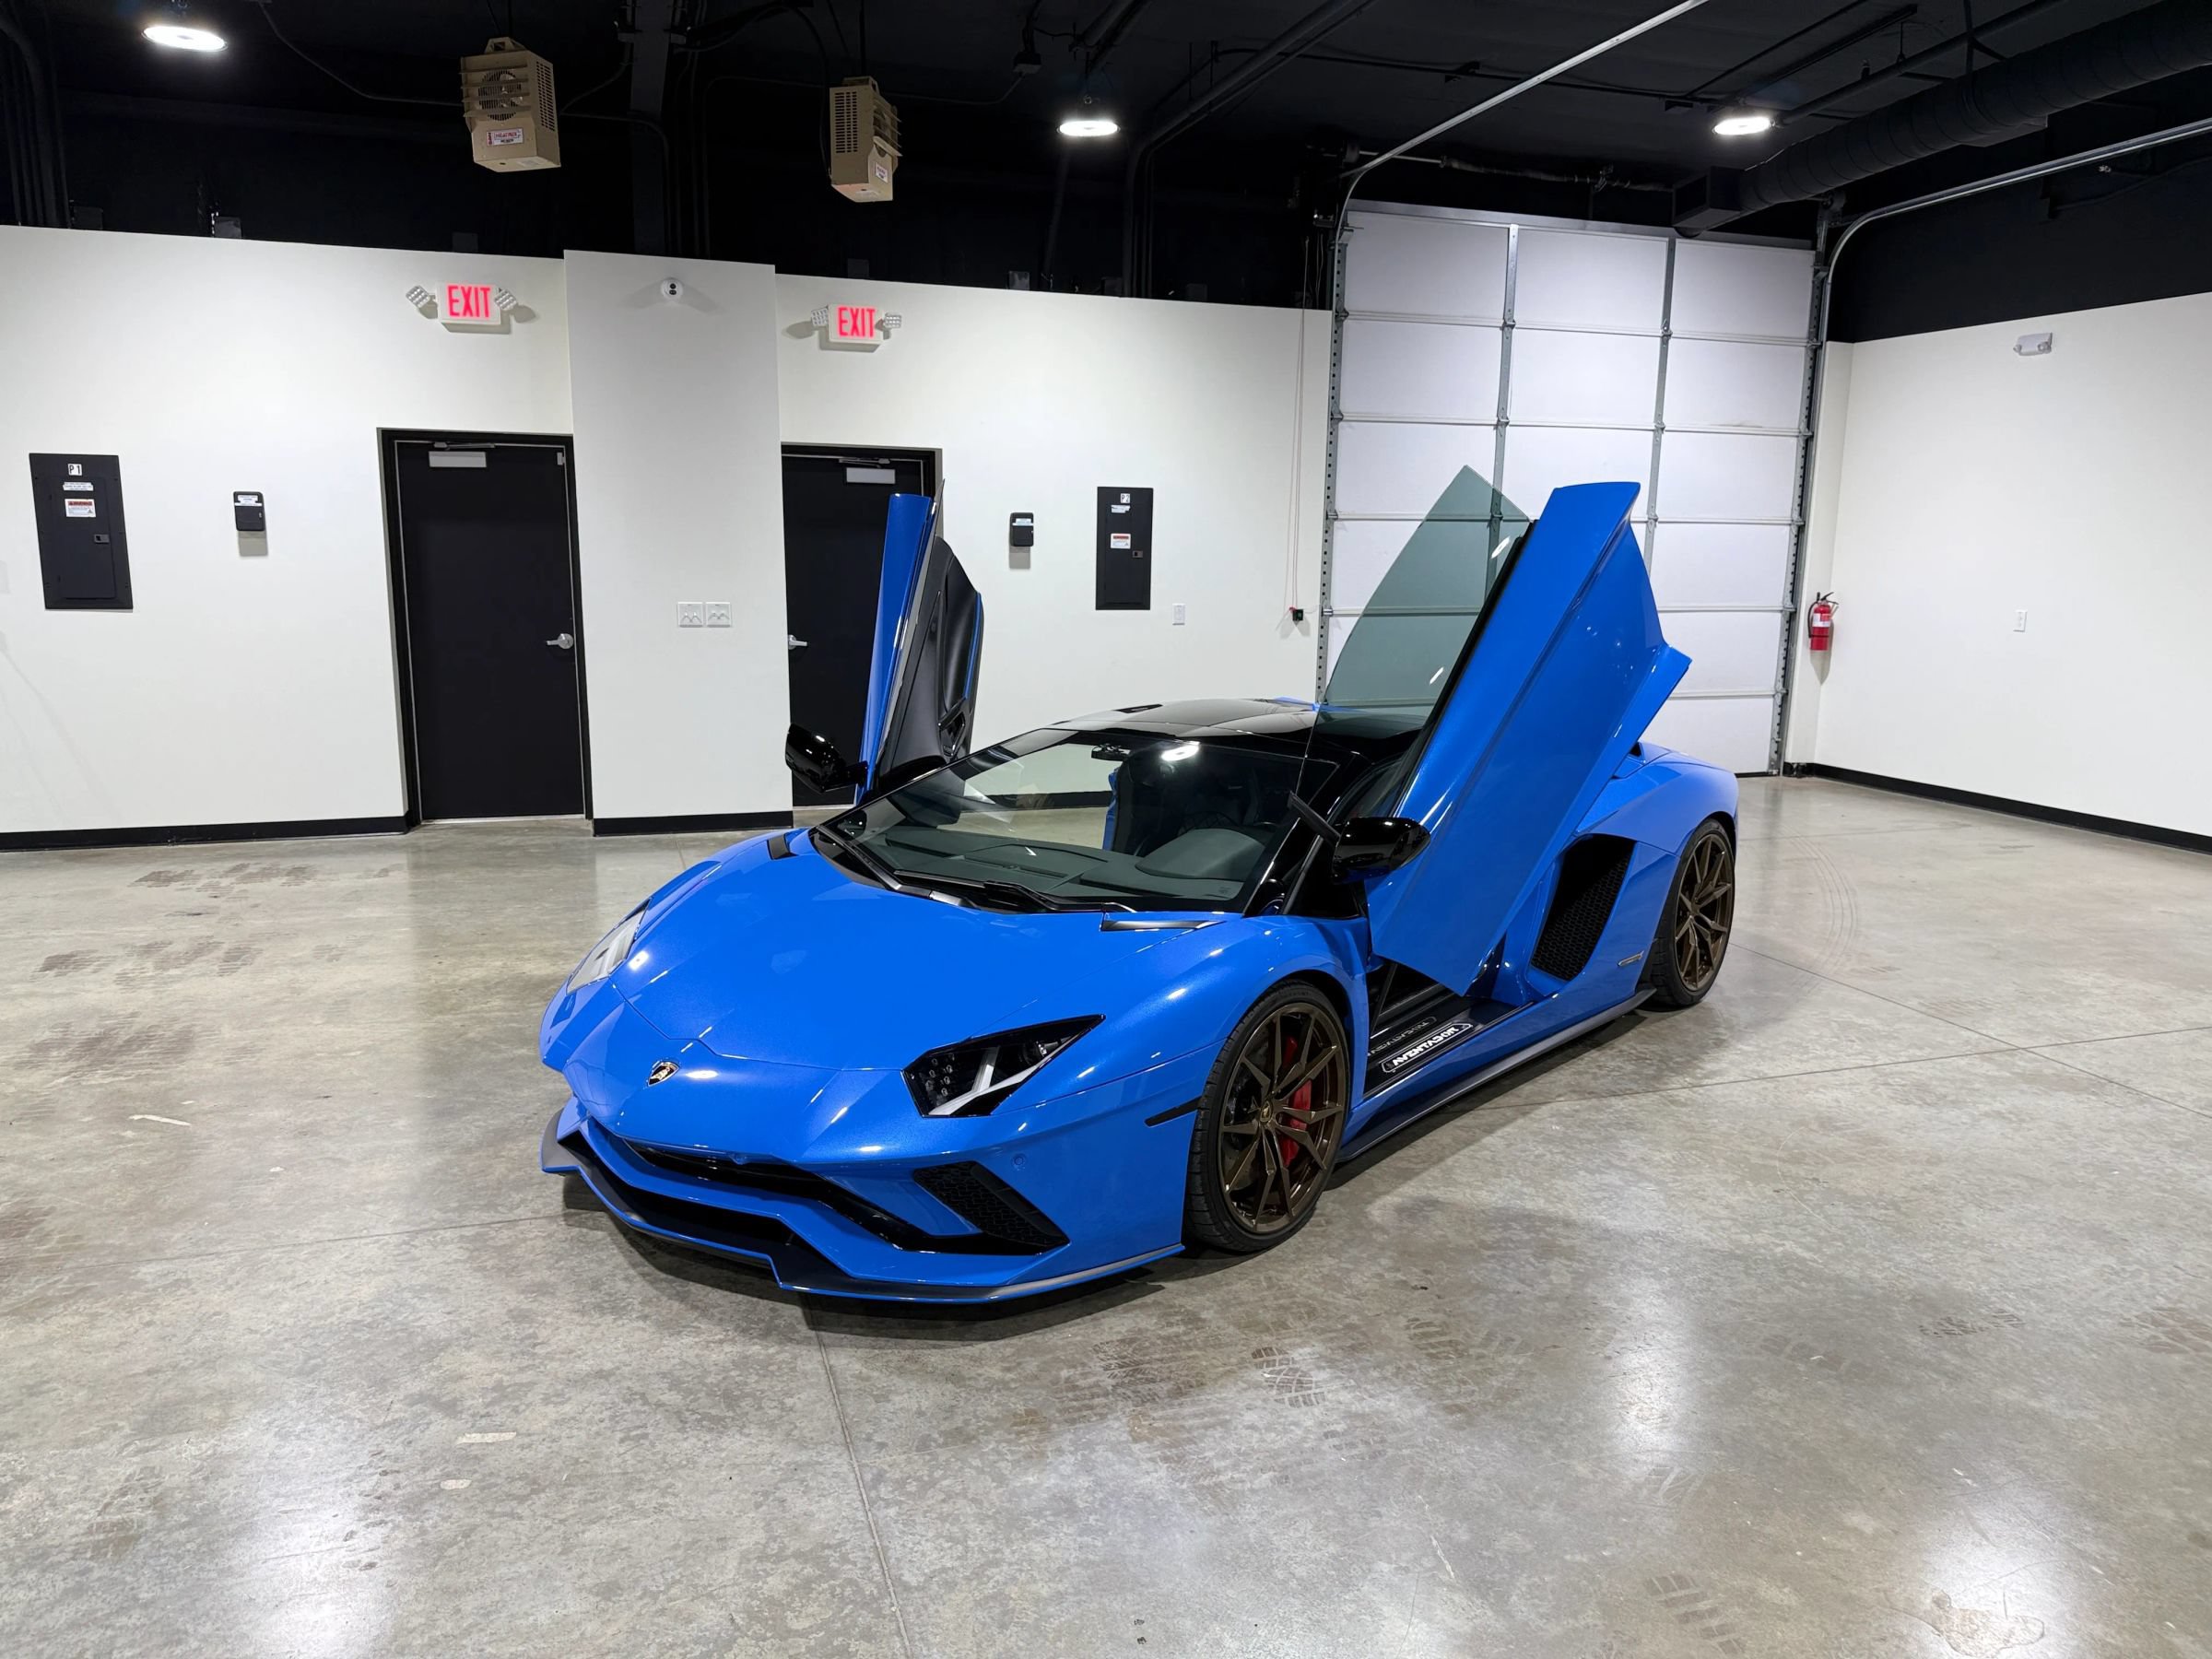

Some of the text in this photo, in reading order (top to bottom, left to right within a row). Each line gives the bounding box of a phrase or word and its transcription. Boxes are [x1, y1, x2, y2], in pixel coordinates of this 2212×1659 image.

[447, 285, 491, 318] EXIT
[837, 307, 876, 338] EXIT
[1393, 1026, 1460, 1066] AVENTADOR
